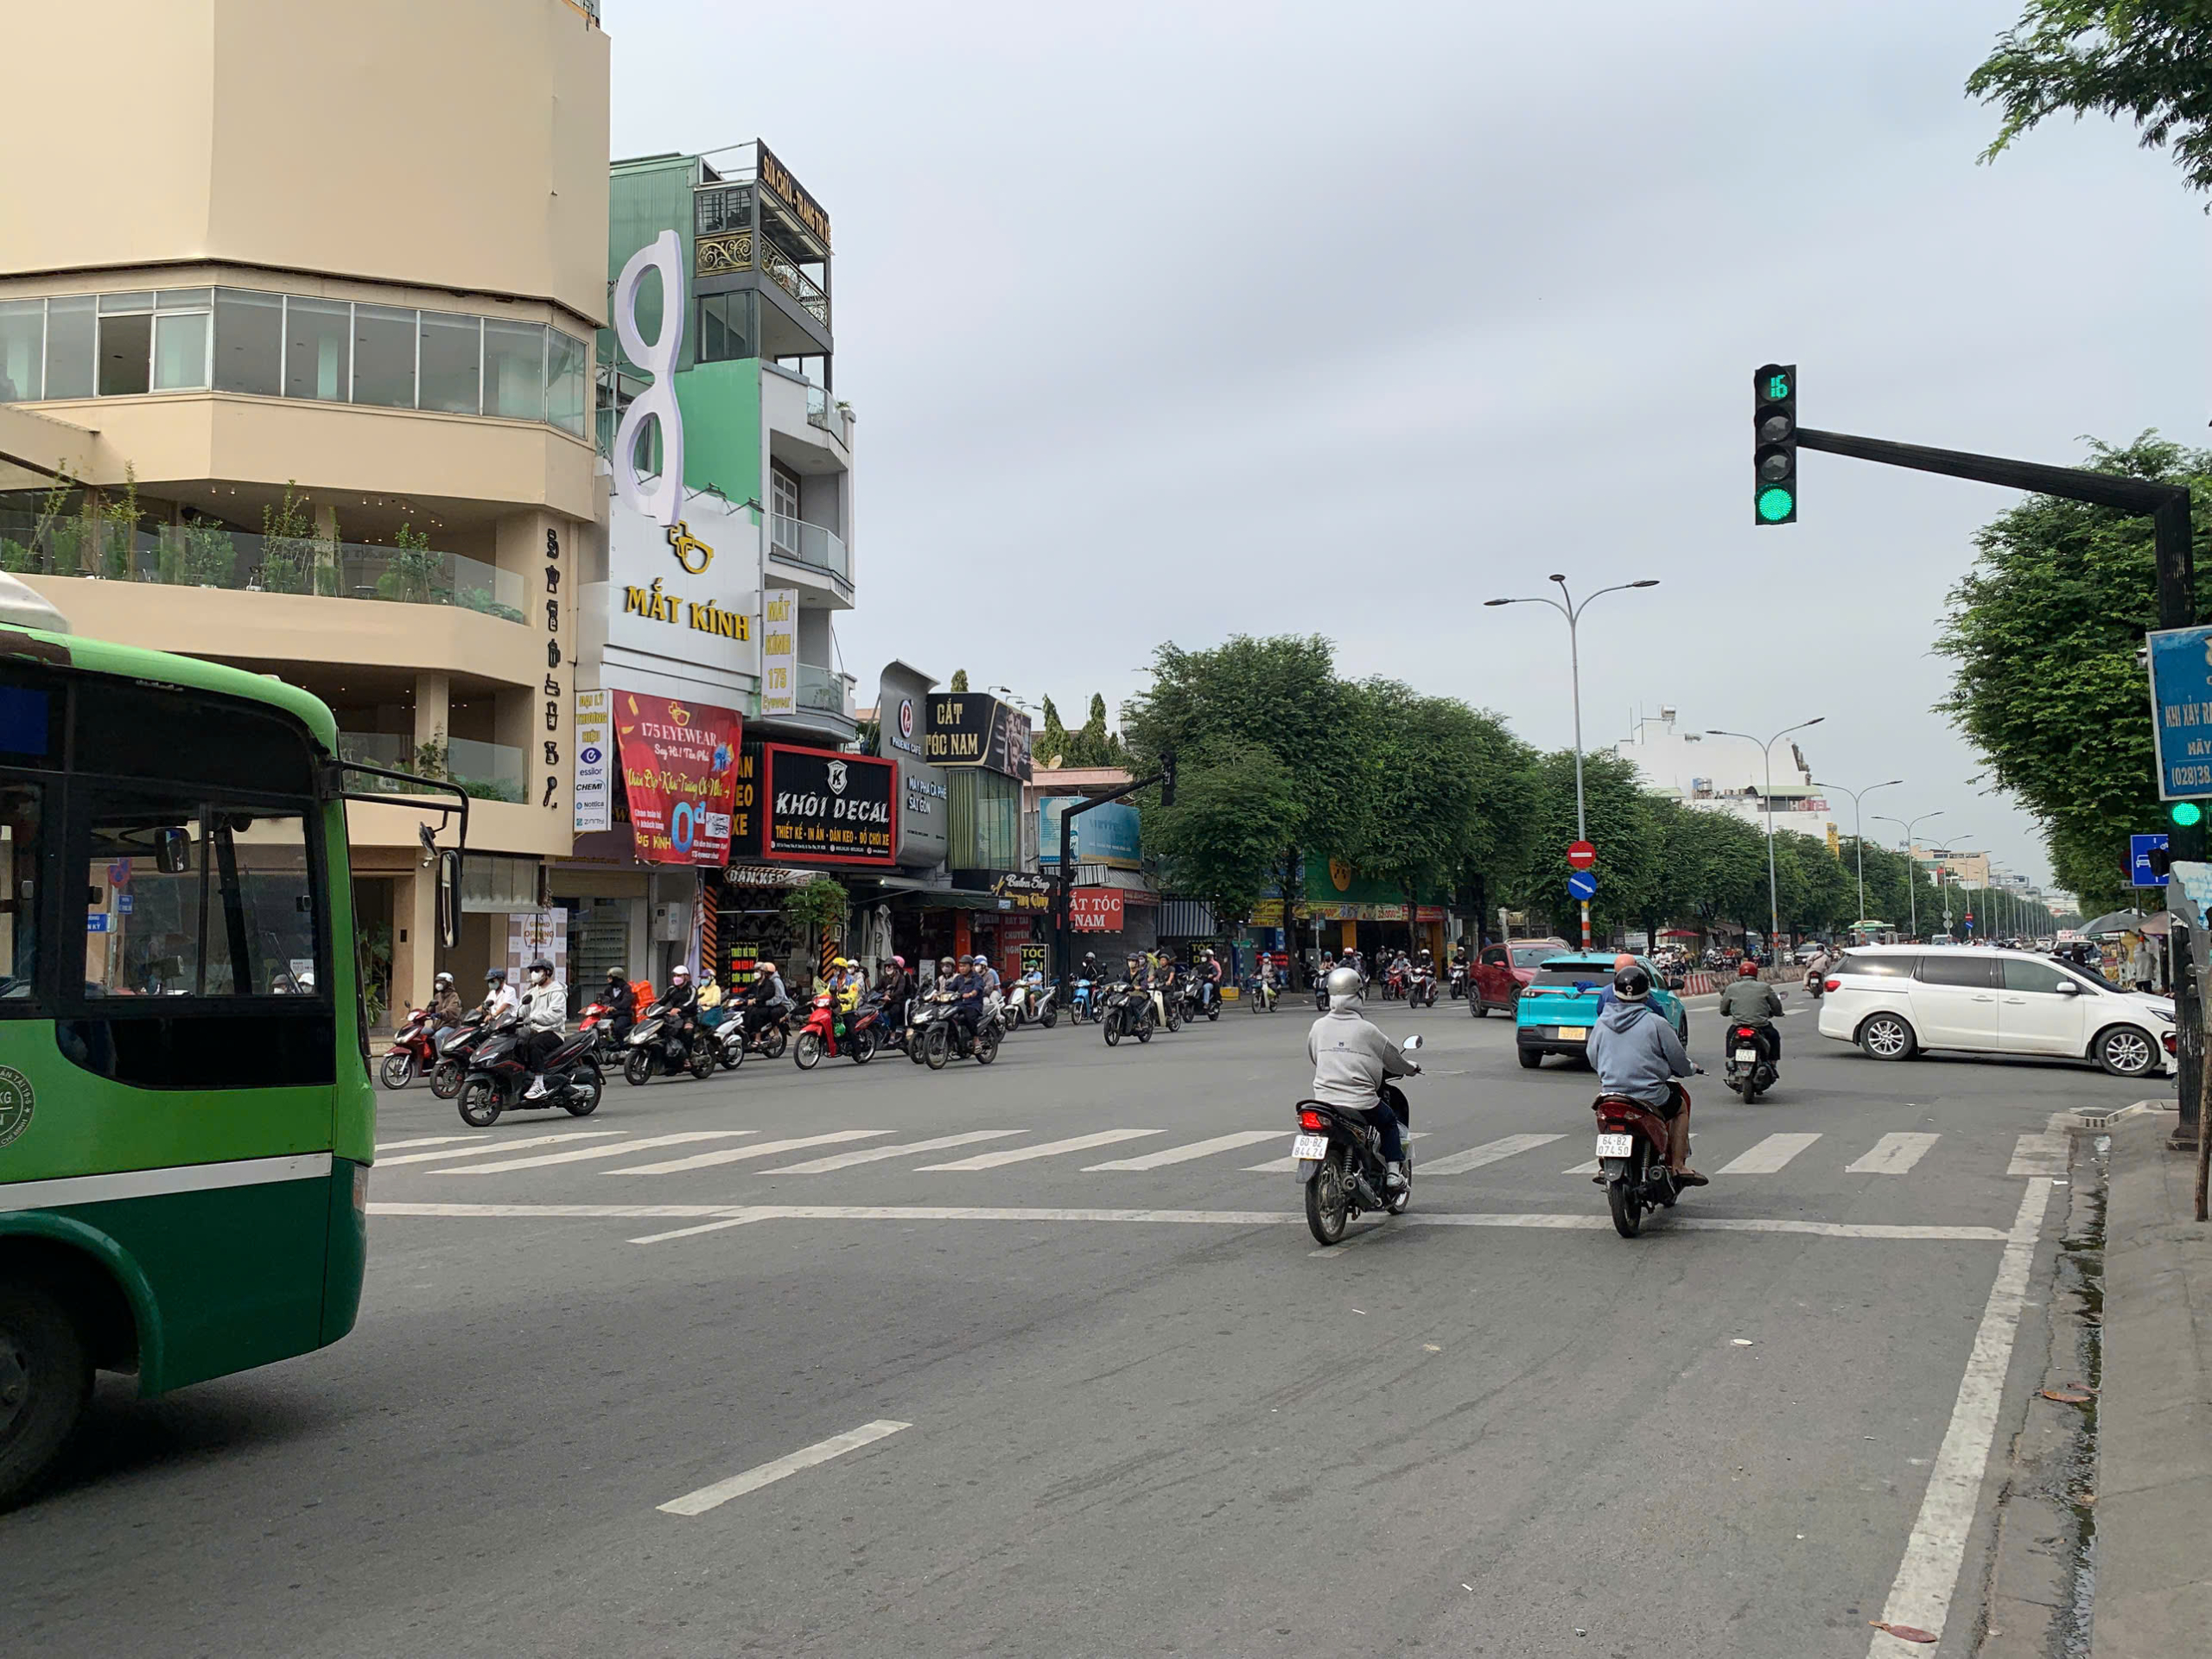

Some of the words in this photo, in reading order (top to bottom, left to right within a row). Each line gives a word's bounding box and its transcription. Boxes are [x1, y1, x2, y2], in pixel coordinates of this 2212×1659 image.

[796, 190, 816, 231] TRANG
[627, 577, 683, 624] MẮT
[689, 599, 750, 641] KÍNH
[767, 593, 791, 622] MẮT
[766, 630, 791, 655] KÍNH
[768, 668, 787, 690] 175
[937, 698, 963, 725] CẮT
[2165, 704, 2182, 728] KHI
[2183, 695, 2200, 726] XẢY
[641, 722, 660, 738] 175
[663, 725, 717, 747] EYEWEAR
[892, 736, 910, 751] PHOENIX
[951, 734, 978, 755] NAM
[2188, 738, 2211, 755] HÃY
[580, 767, 602, 776] essilor
[736, 784, 753, 806] EO
[908, 775, 920, 792] MÁY
[920, 780, 931, 796] PHA
[775, 791, 829, 817] KHÔI
[833, 798, 890, 823] DECAL
[732, 814, 748, 836] XE
[775, 821, 793, 839] THIẾT
[795, 822, 803, 840] KẾ
[808, 828, 814, 841] IN
[816, 823, 824, 841] ẤN
[830, 827, 842, 842] DÁN
[842, 830, 854, 843] KEO
[882, 834, 890, 846] XE
[1070, 891, 1088, 911] ẮT
[1092, 894, 1121, 912] TÓC
[1074, 914, 1105, 927] NAM
[1021, 946, 1045, 958] TÓC
[1598, 1146, 1629, 1155] 074.50
[1602, 1136, 1627, 1146] 64-B2
